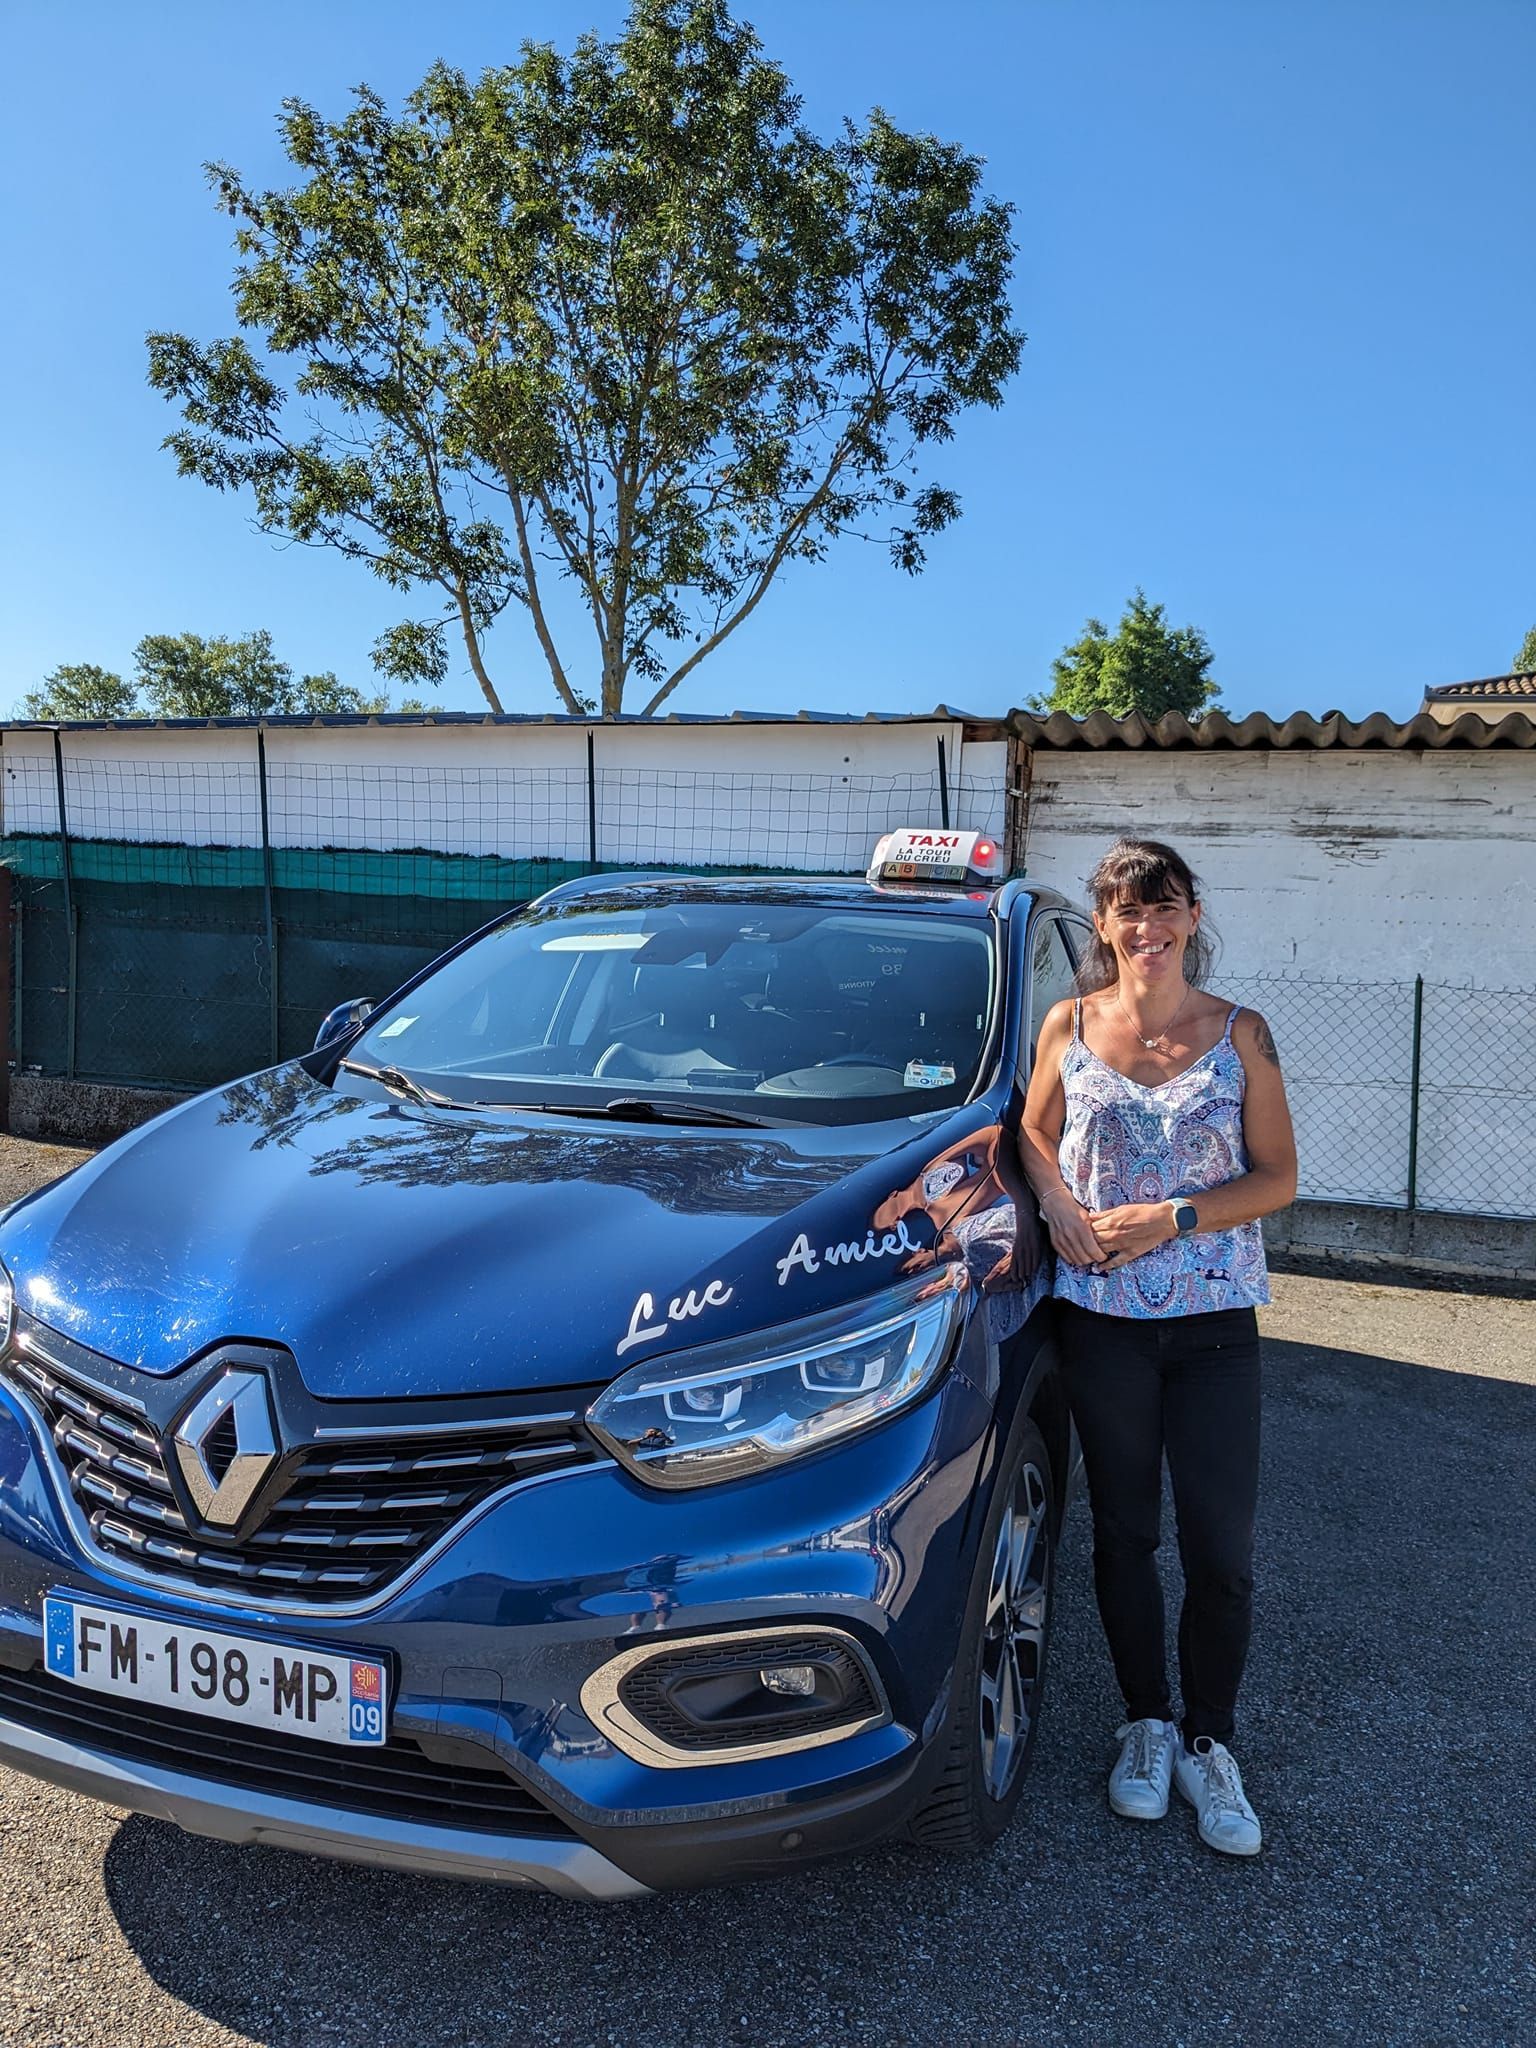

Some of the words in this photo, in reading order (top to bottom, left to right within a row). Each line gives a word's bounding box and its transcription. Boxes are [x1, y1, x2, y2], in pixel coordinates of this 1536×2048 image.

[907, 834, 960, 848] TAXI
[895, 854, 910, 862] DU
[914, 855, 951, 863] CRIEU
[898, 847, 913, 855] LA
[919, 848, 952, 856] TOUR
[887, 864, 897, 873] A
[903, 864, 913, 874] B
[934, 865, 944, 875] C
[776, 1220, 921, 1286] Amiel
[616, 1280, 733, 1356] Luc
[56, 1644, 66, 1661] F
[79, 1616, 338, 1723] FM-198-MP
[351, 1703, 380, 1736] 09
